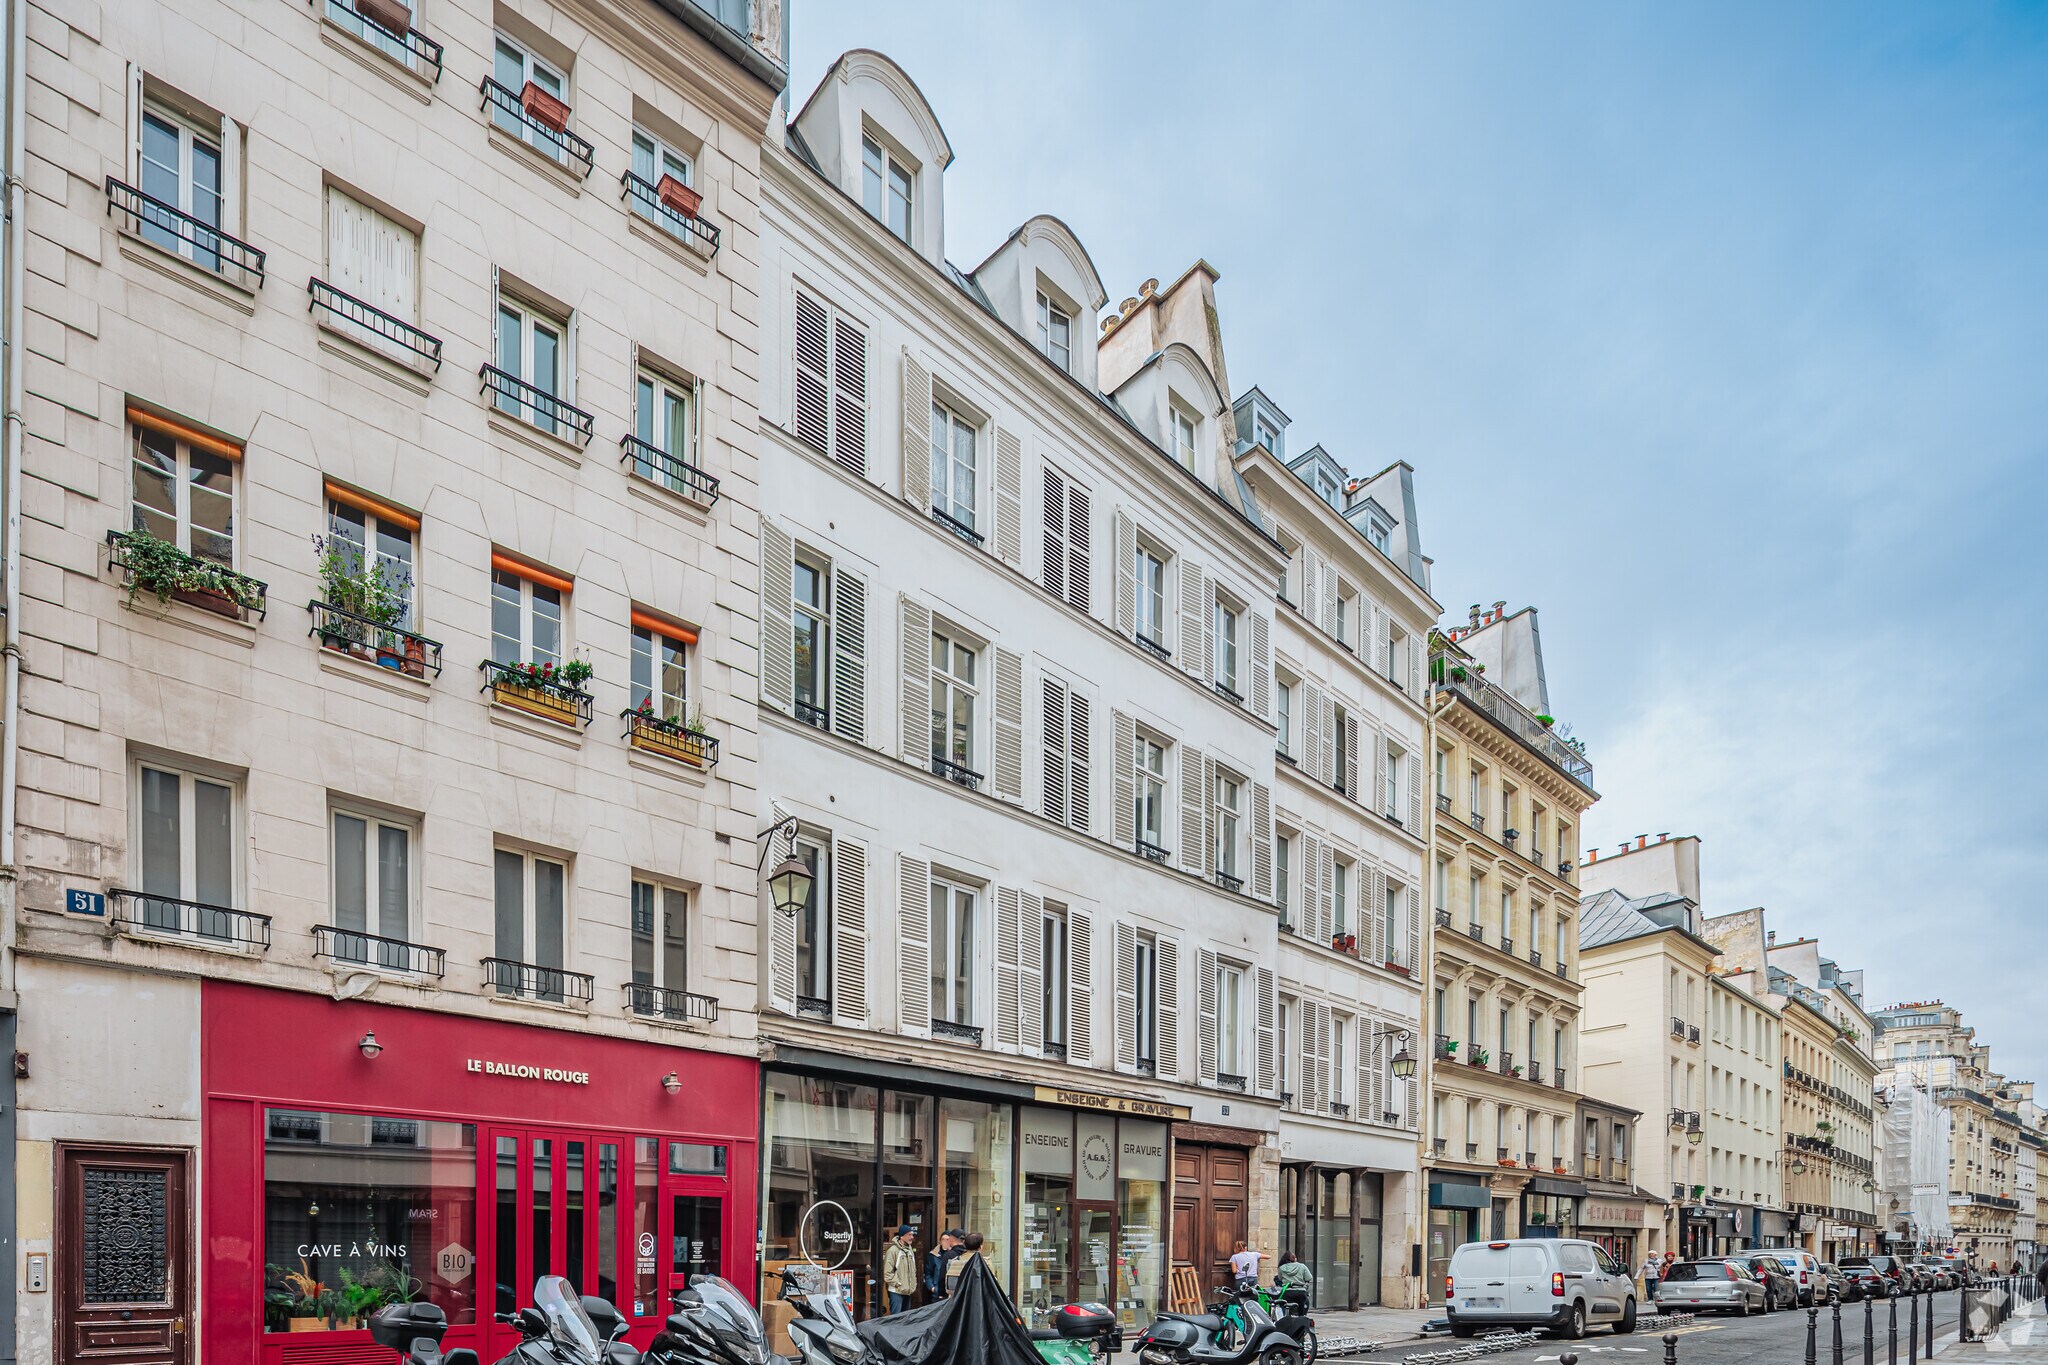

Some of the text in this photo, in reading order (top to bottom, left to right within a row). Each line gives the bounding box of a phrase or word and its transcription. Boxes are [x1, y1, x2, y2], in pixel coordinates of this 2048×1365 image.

[75, 892, 96, 912] 51
[467, 1058, 589, 1084] LE BALLON ROUGE
[1057, 1092, 1175, 1117] ENSEIGNE & GRAVURE
[1025, 1133, 1069, 1148] ENSEIGNE
[1087, 1153, 1107, 1162] A.G.S.
[1123, 1143, 1162, 1157] GRAVURE
[823, 1231, 852, 1241] Superfly
[297, 1241, 407, 1257] CAVE À VINS
[443, 1254, 466, 1269] BIO
